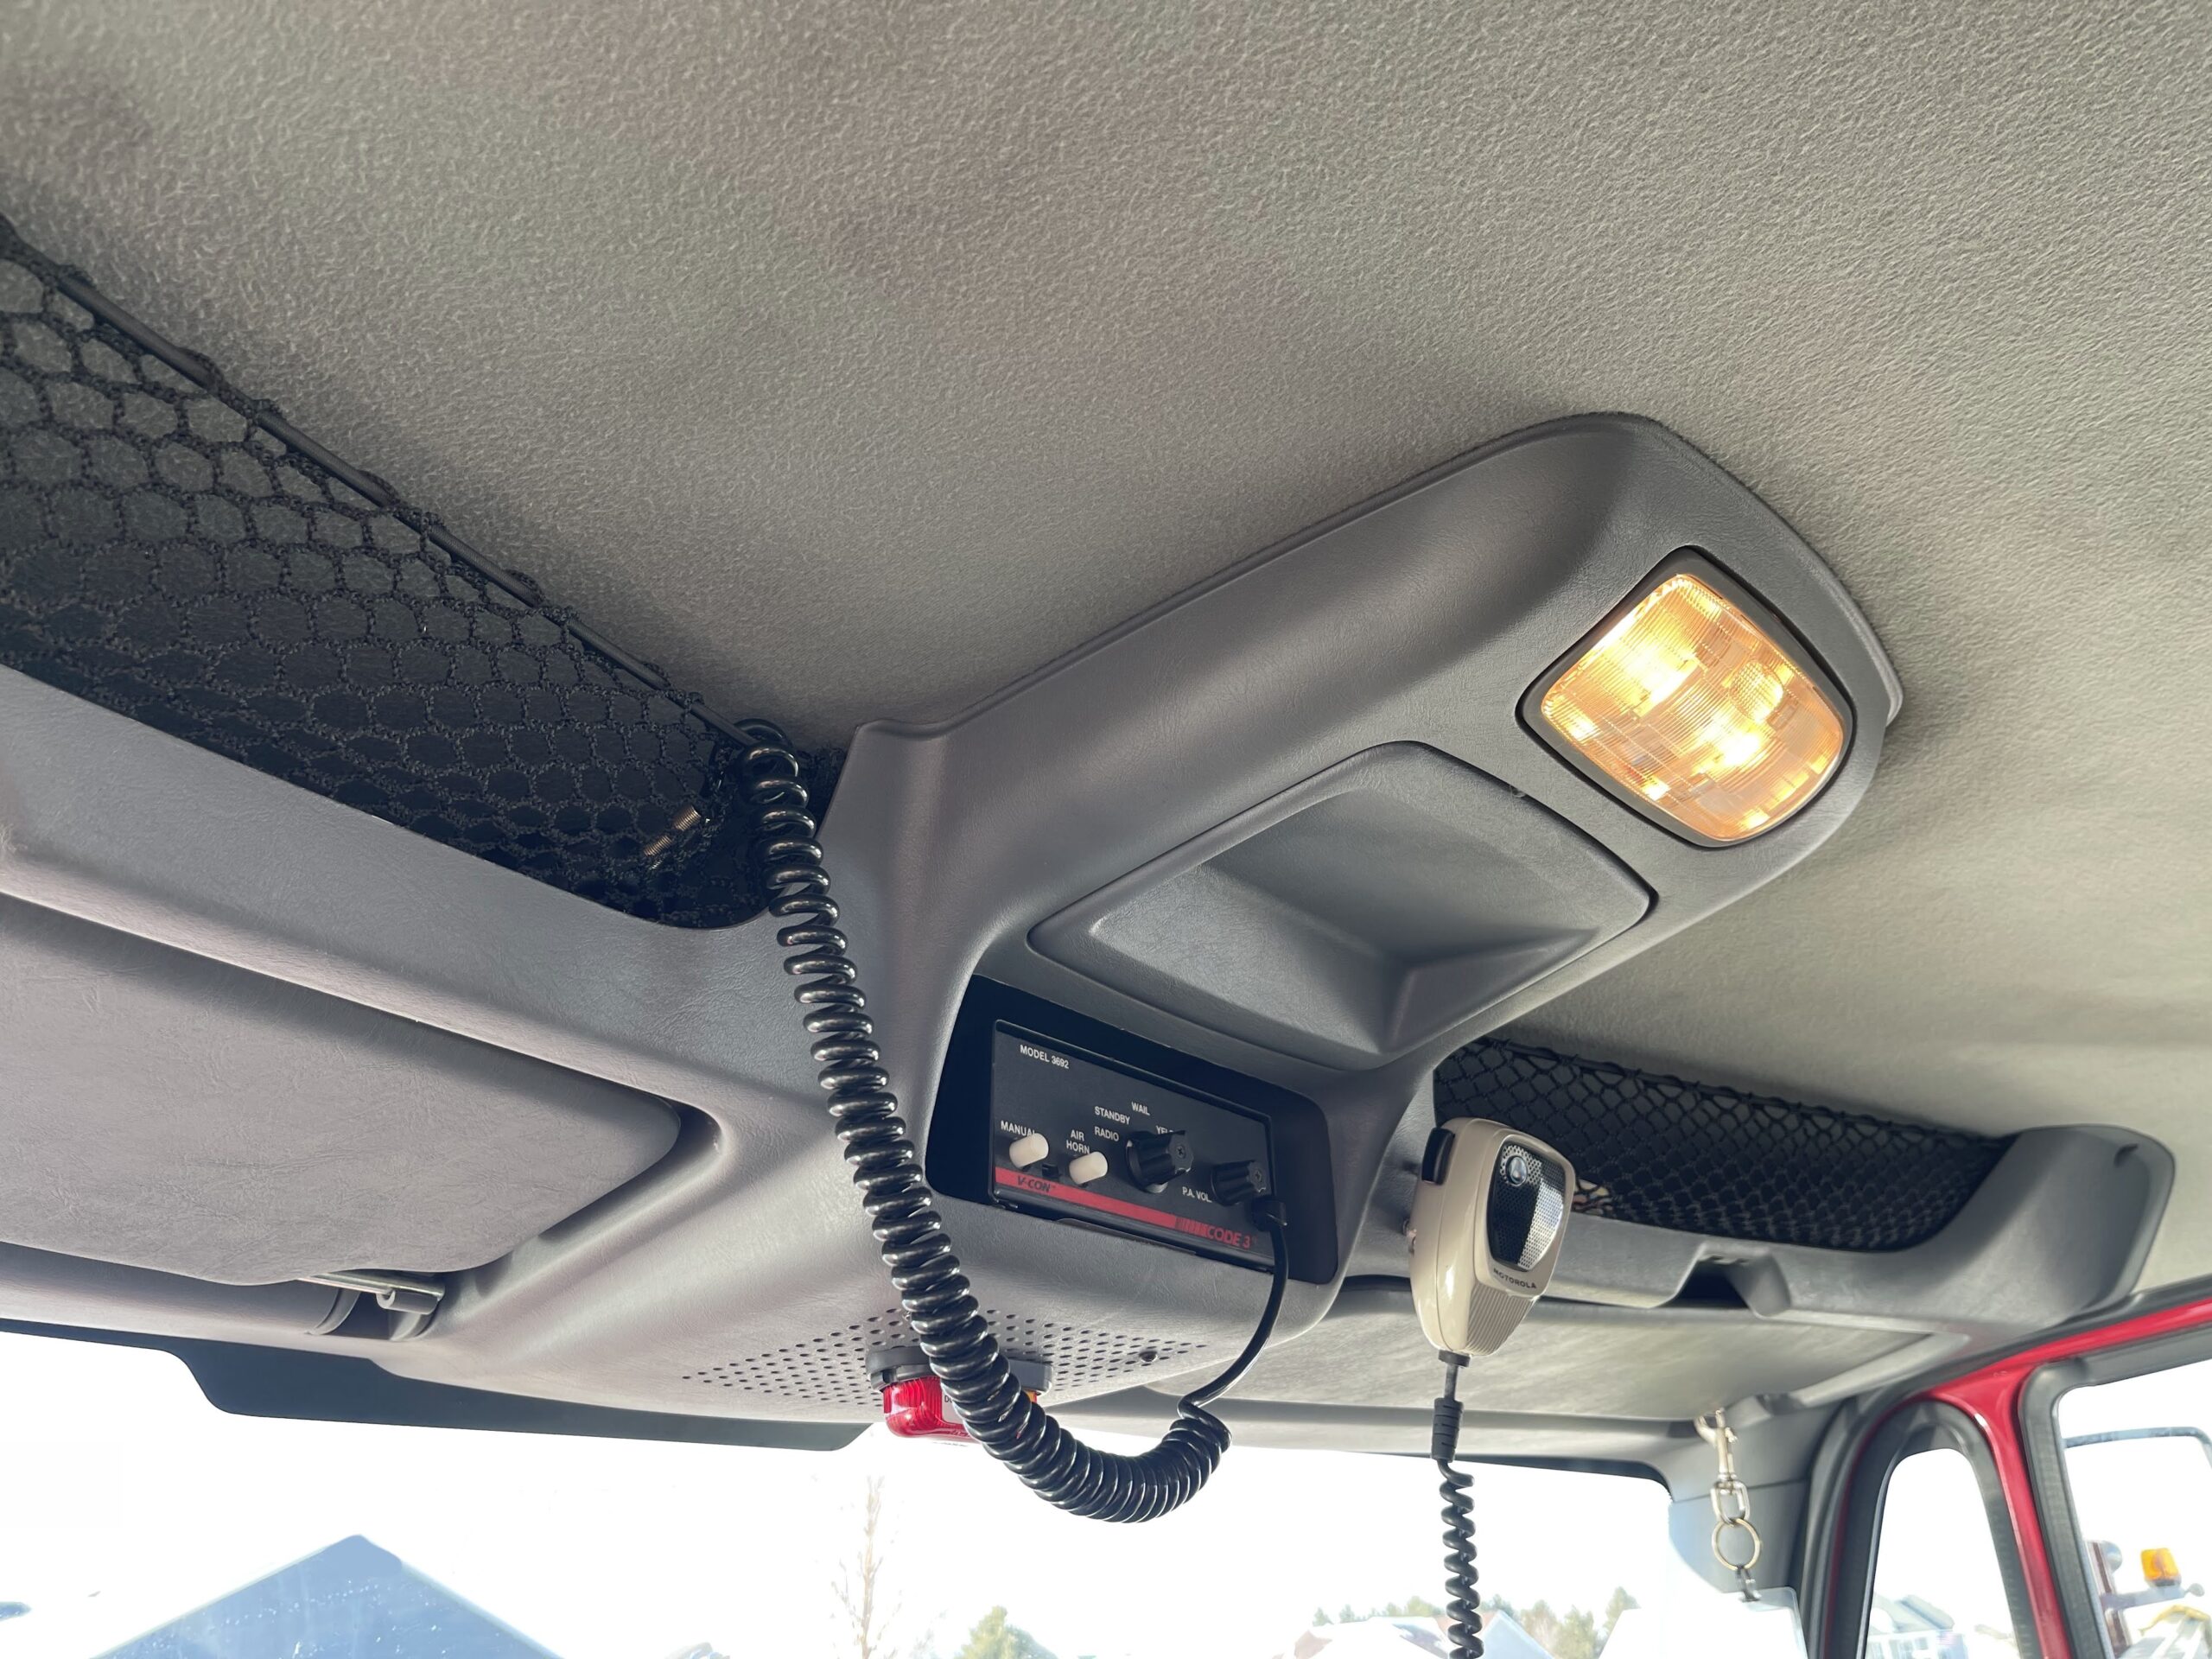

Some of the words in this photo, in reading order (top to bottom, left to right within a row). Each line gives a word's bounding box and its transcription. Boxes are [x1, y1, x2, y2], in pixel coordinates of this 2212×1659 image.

[1020, 1044, 1050, 1063] MODEL
[1051, 1055, 1070, 1069] 3692
[1094, 1106, 1130, 1125] STANDBY
[1131, 1101, 1150, 1116] WAIL
[1070, 1129, 1084, 1141] AIR
[1094, 1126, 1119, 1141] RADIO
[1065, 1140, 1090, 1154] HORN
[1207, 1225, 1242, 1247] CODE
[1243, 1236, 1250, 1249] 3
[1493, 1268, 1536, 1289] MOTOROLA
